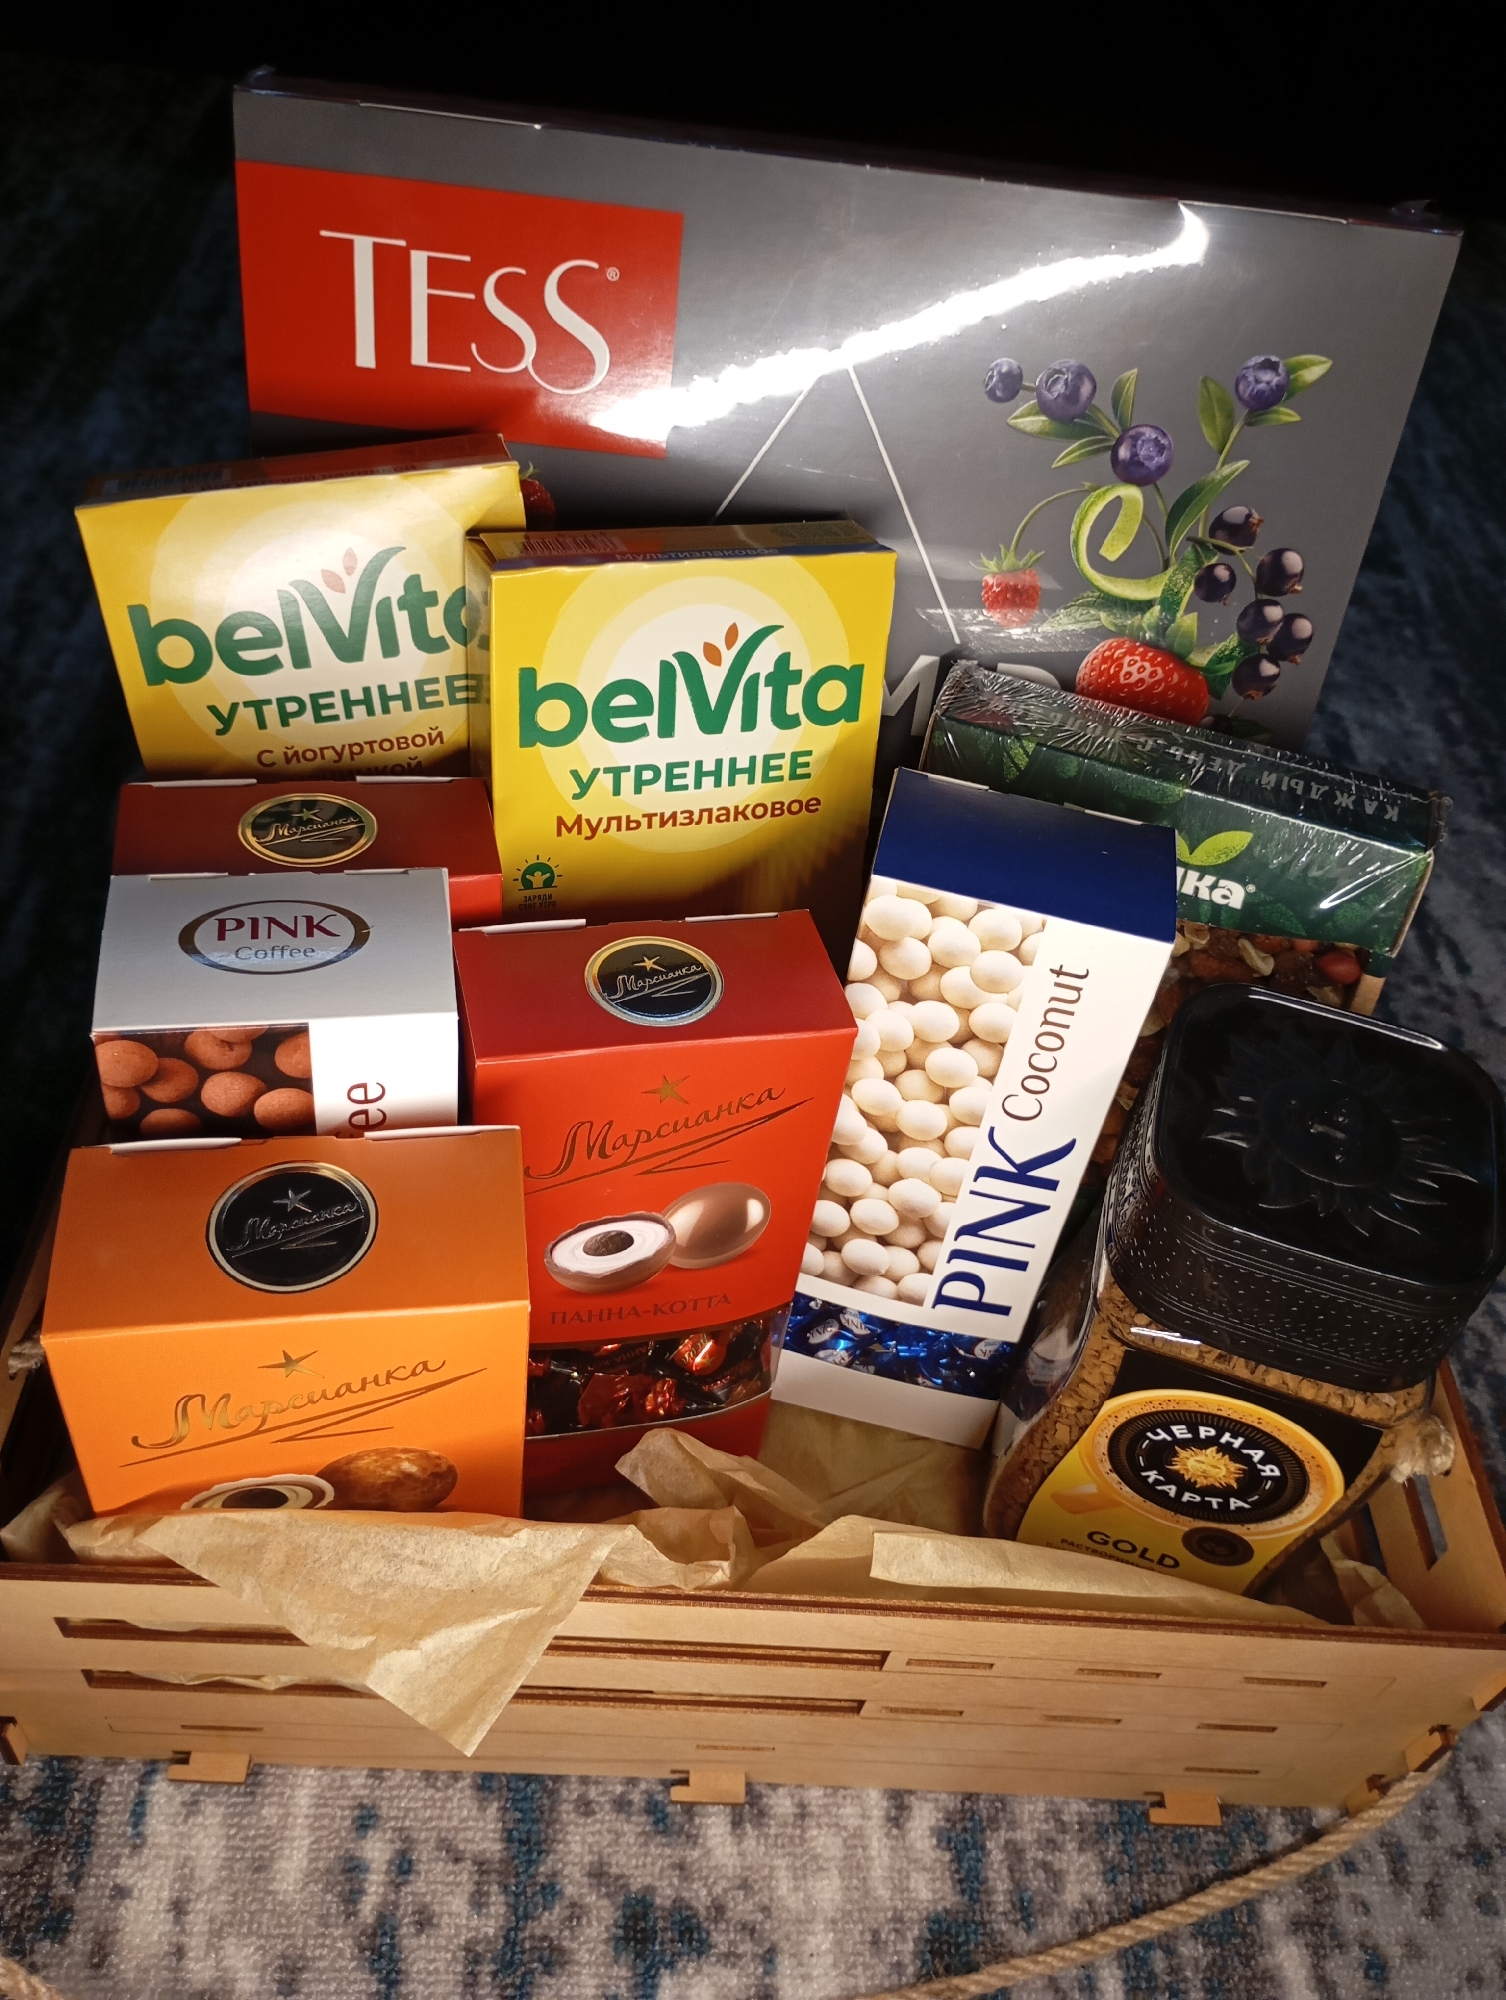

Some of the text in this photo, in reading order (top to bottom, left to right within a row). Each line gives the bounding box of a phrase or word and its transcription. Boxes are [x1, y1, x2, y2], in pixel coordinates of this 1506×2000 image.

[319, 230, 611, 396] TESS
[518, 624, 865, 749] belVita
[256, 726, 446, 768] С йогуртовой
[1166, 745, 1247, 779] ДЕНЬ
[569, 750, 814, 801] УТРЕННЕЕ
[1261, 769, 1400, 823] КАЖДЫЙ
[255, 814, 360, 844] Марсианка
[556, 796, 823, 840] Мультизлаковое
[214, 914, 341, 943] PINK
[234, 943, 316, 962] Coffee
[601, 962, 702, 1001] Марсианка
[525, 1088, 786, 1180] Марсианка
[931, 963, 1090, 1318] PINK Coconut
[227, 1199, 358, 1252] Марсианка
[550, 1293, 731, 1325] ПАННА-КОТТА
[131, 1358, 446, 1450] Марсианка
[1146, 1424, 1282, 1479] ЧЕРНАЯ
[1140, 1469, 1252, 1511] КАРТА
[1086, 1530, 1181, 1570] GOLD
